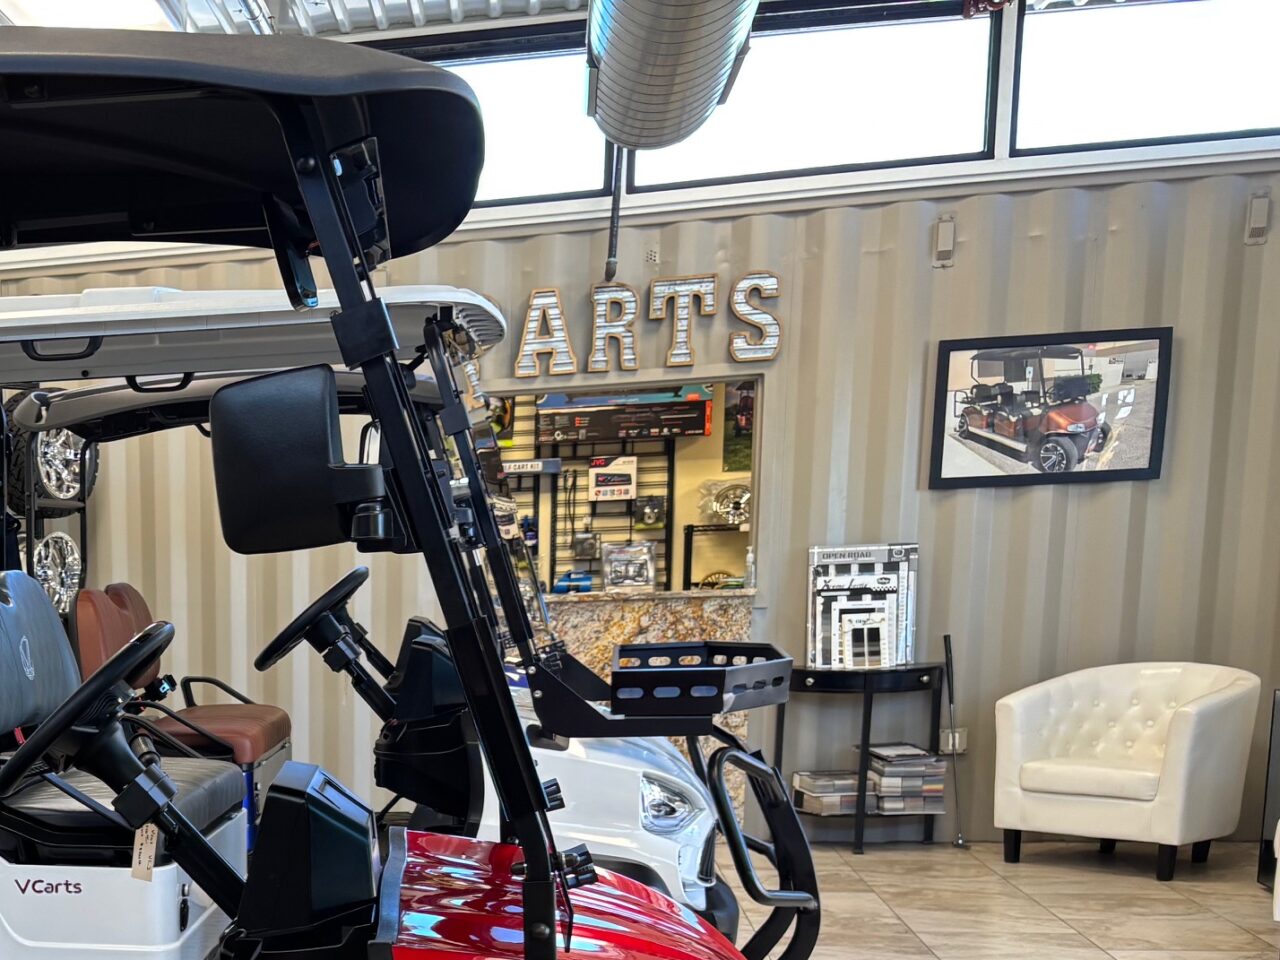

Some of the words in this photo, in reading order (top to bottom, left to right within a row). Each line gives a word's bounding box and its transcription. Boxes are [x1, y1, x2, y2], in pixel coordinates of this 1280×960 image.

[590, 459, 606, 467] JVC
[822, 552, 846, 560] OPEN
[847, 550, 872, 559] ROAD
[15, 879, 82, 895] VCarts
